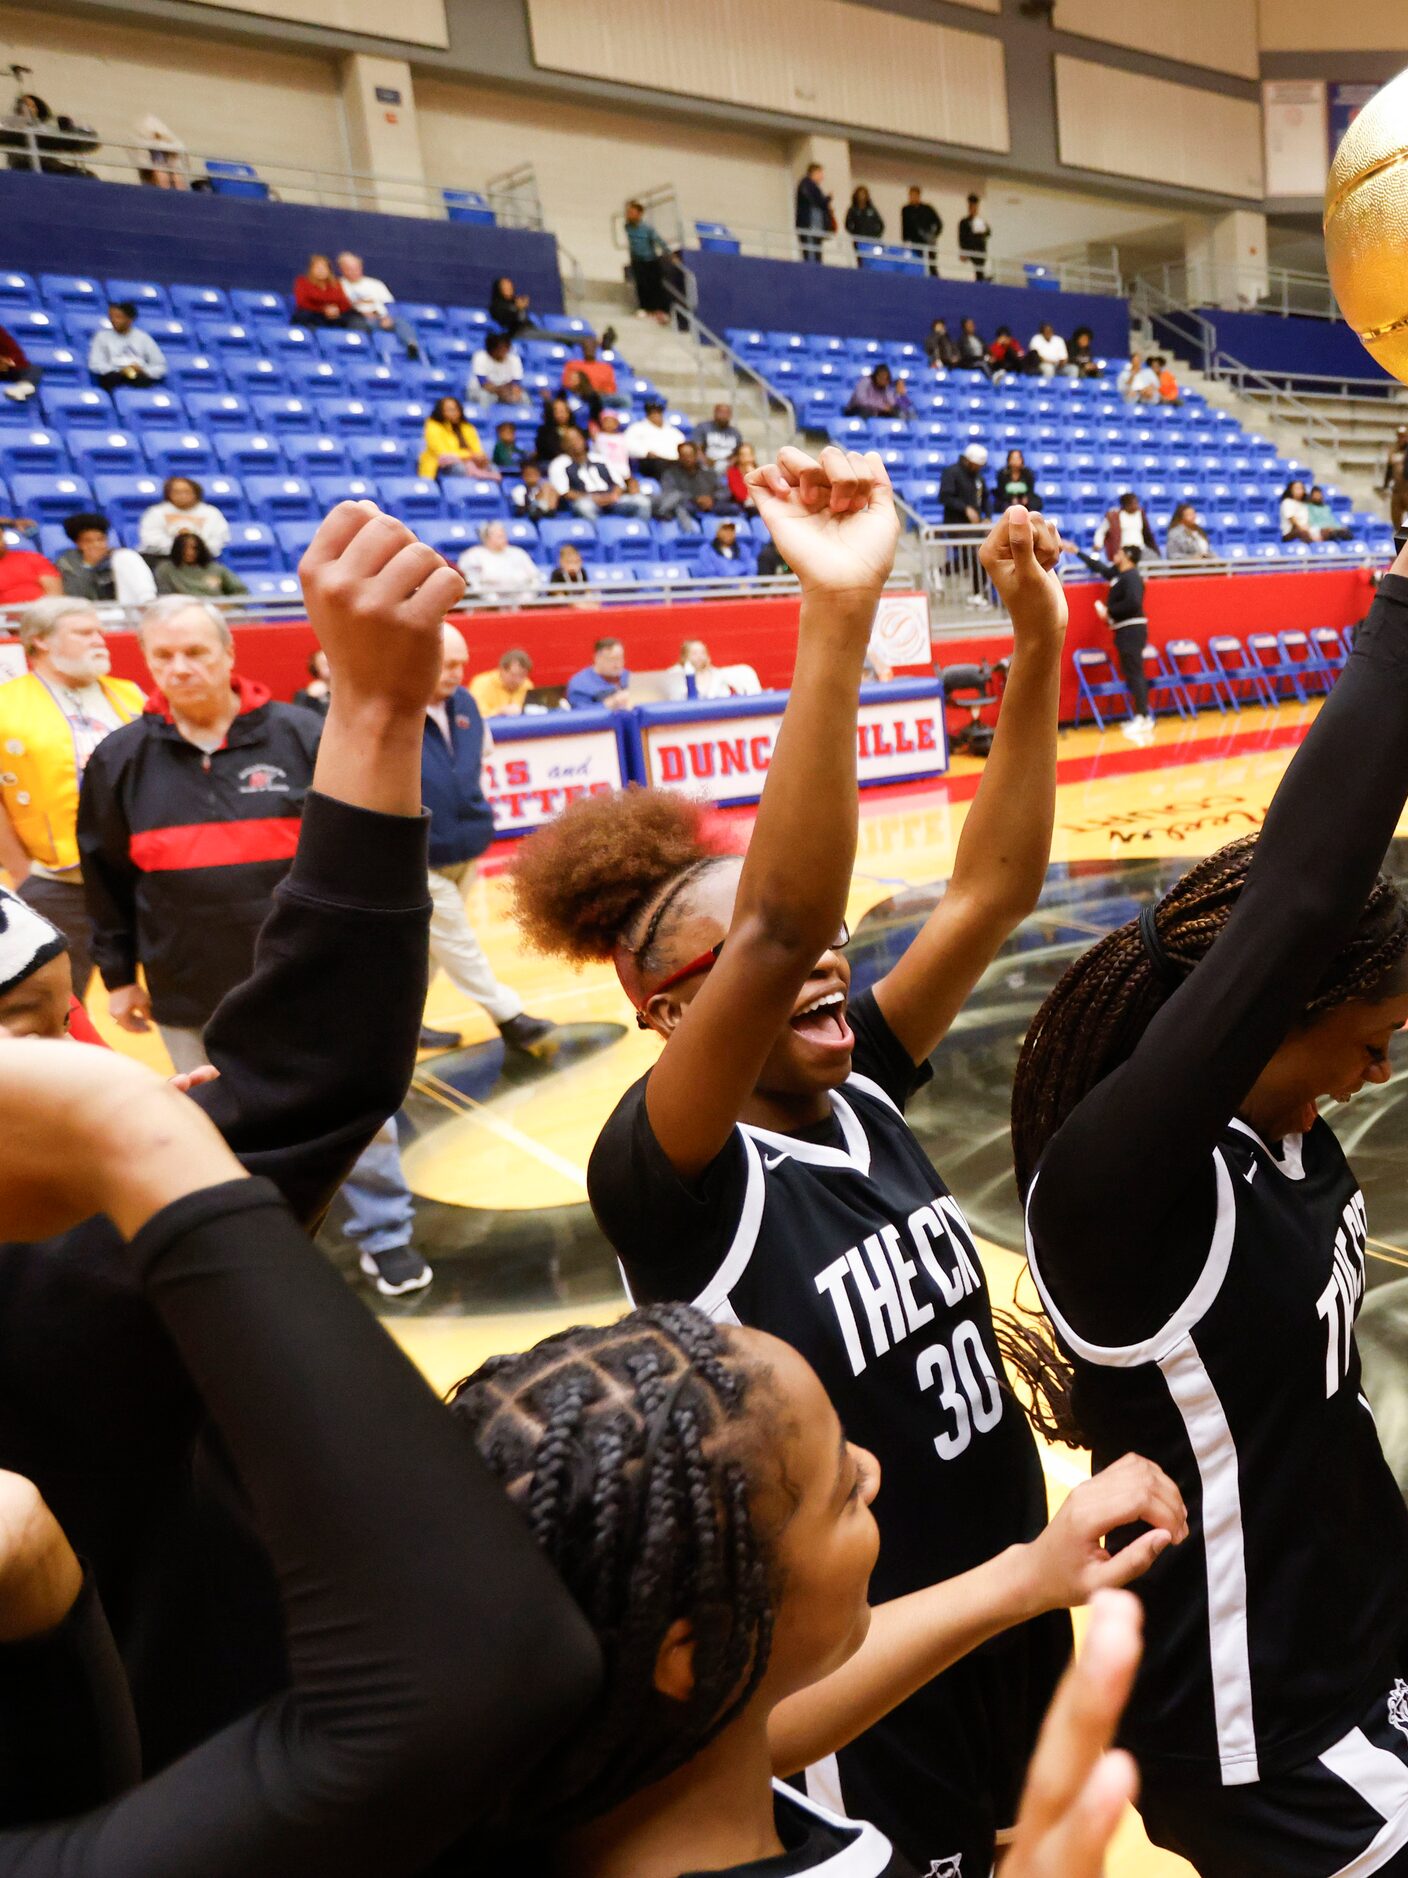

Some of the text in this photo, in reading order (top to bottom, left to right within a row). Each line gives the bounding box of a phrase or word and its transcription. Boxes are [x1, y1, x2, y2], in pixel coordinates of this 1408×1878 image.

[548, 755, 593, 779] and
[658, 718, 937, 783] DUNCILLE
[814, 1224, 935, 1377] THE
[916, 1319, 1004, 1462] 30
